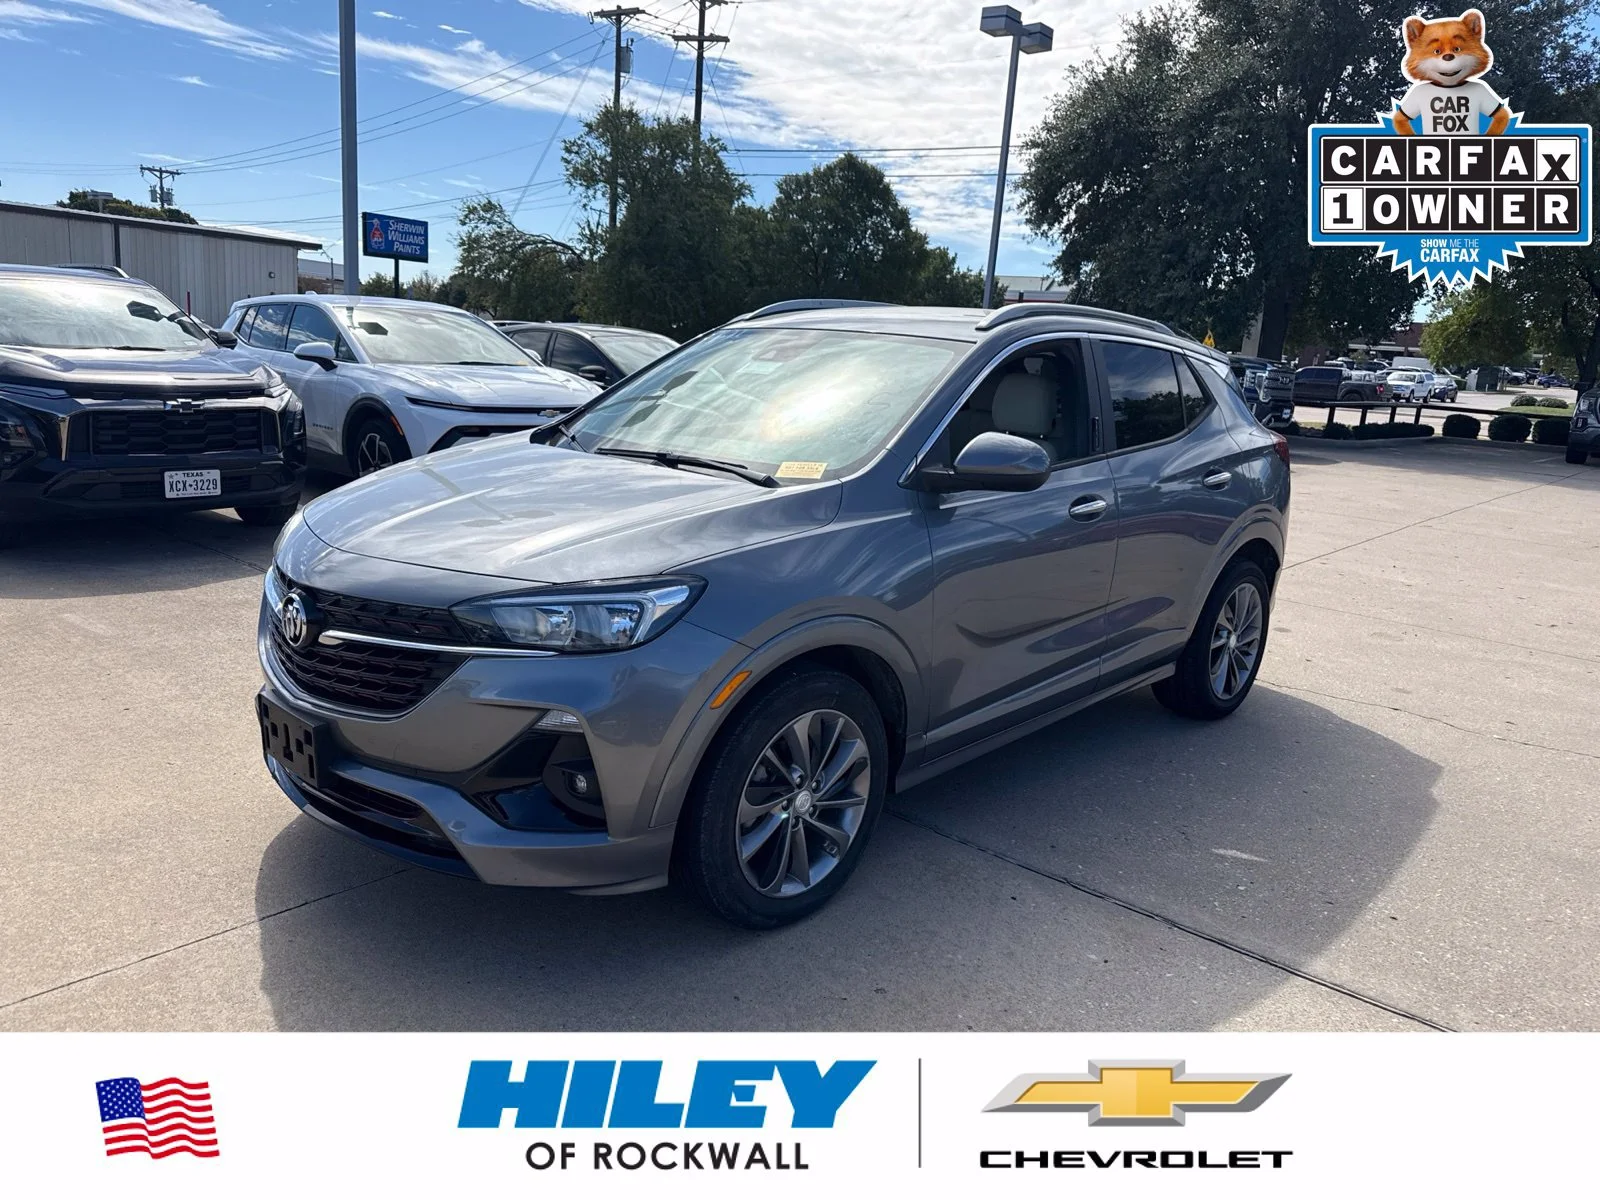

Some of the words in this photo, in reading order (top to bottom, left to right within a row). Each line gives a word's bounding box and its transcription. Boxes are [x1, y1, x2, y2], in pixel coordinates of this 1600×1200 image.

[389, 220, 425, 235] SHERWIN
[388, 230, 425, 245] WILLIAMS
[393, 241, 421, 255] PAINTS
